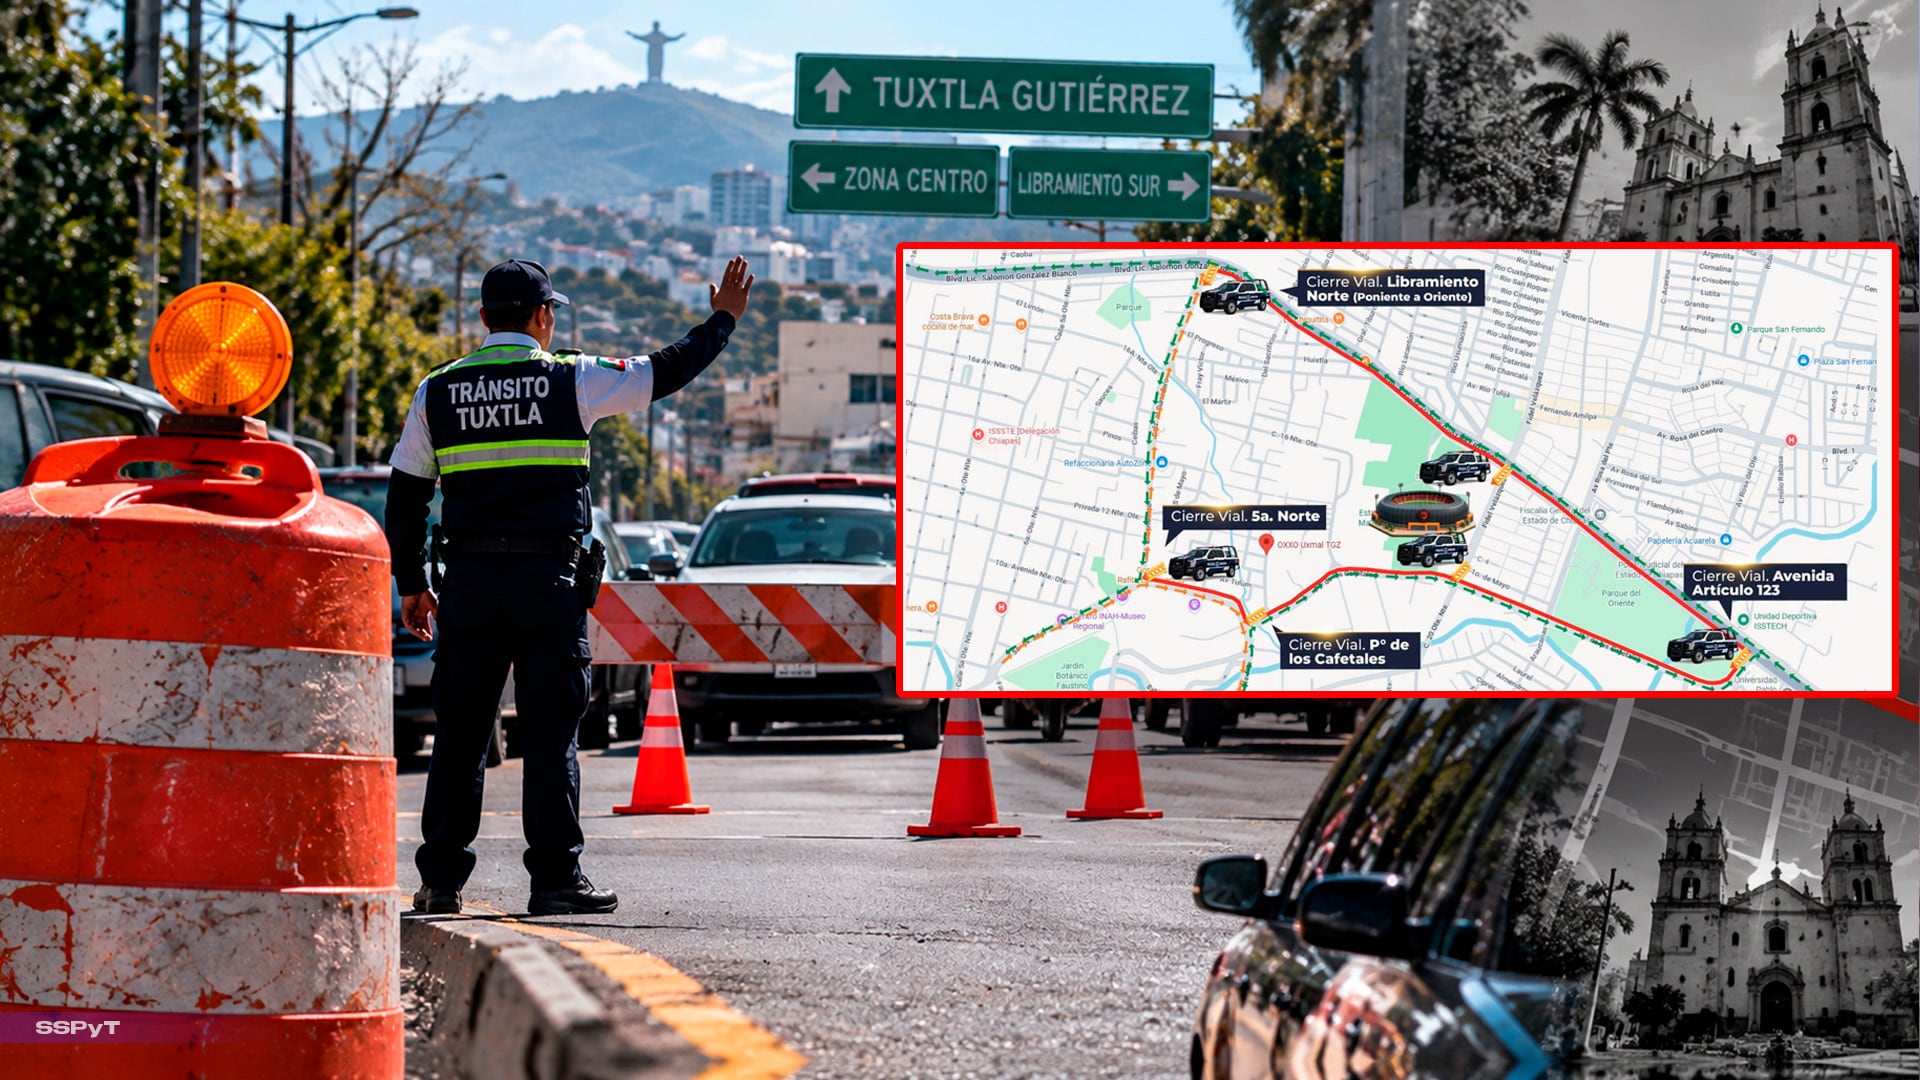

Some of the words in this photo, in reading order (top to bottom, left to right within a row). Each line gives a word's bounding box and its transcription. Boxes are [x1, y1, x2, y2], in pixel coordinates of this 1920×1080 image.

[873, 76, 1000, 111] TUXTLA
[1011, 75, 1190, 116] GUTIÉRREZ
[844, 166, 899, 192] ZONA
[906, 167, 988, 194] CENTRO
[1018, 172, 1123, 198] LIBRAMIENTO
[1128, 174, 1161, 198] SUR
[448, 375, 550, 406] TRÁNSITO
[456, 402, 544, 431] TUXTLA
